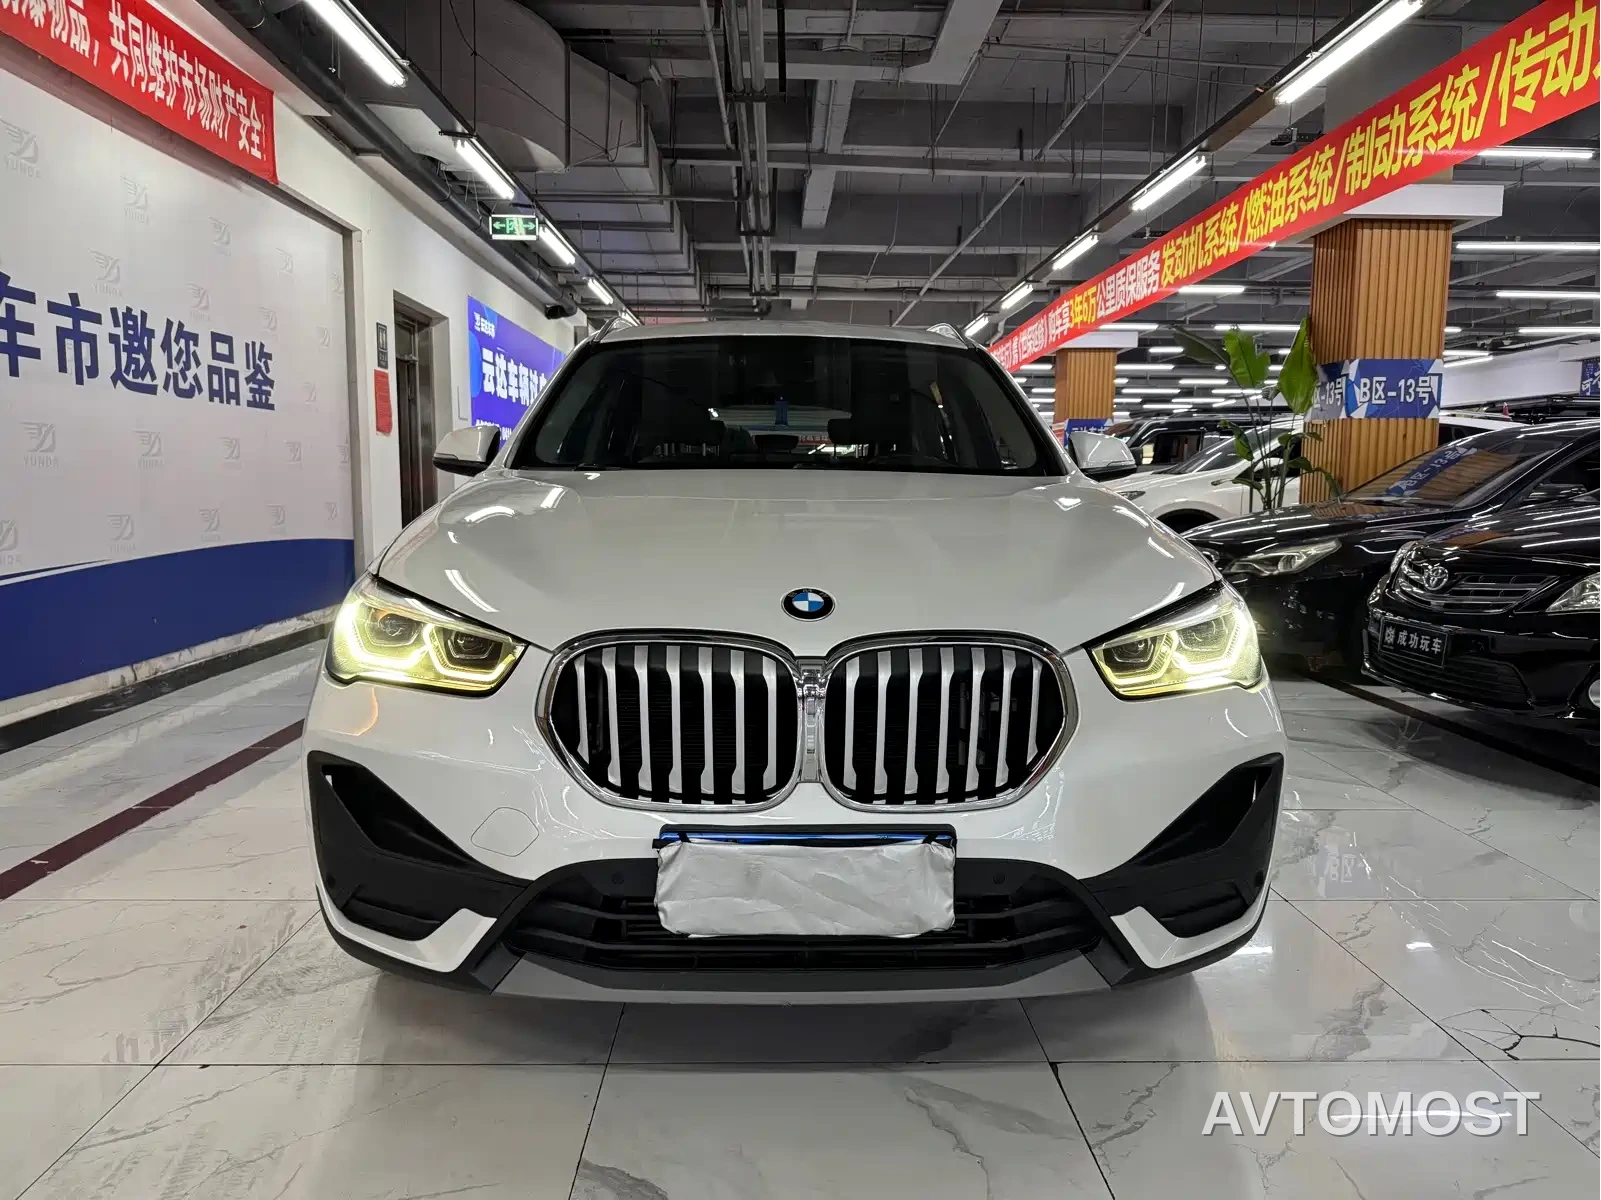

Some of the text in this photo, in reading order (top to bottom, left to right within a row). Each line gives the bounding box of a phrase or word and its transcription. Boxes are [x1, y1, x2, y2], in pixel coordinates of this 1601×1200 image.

[0, 0, 267, 161] 物品，共同维护市场财产安全！
[0, 271, 276, 411] 车市邀您品鉴
[1361, 376, 1432, 405] B区-13号
[1397, 629, 1443, 654] 成功玩车
